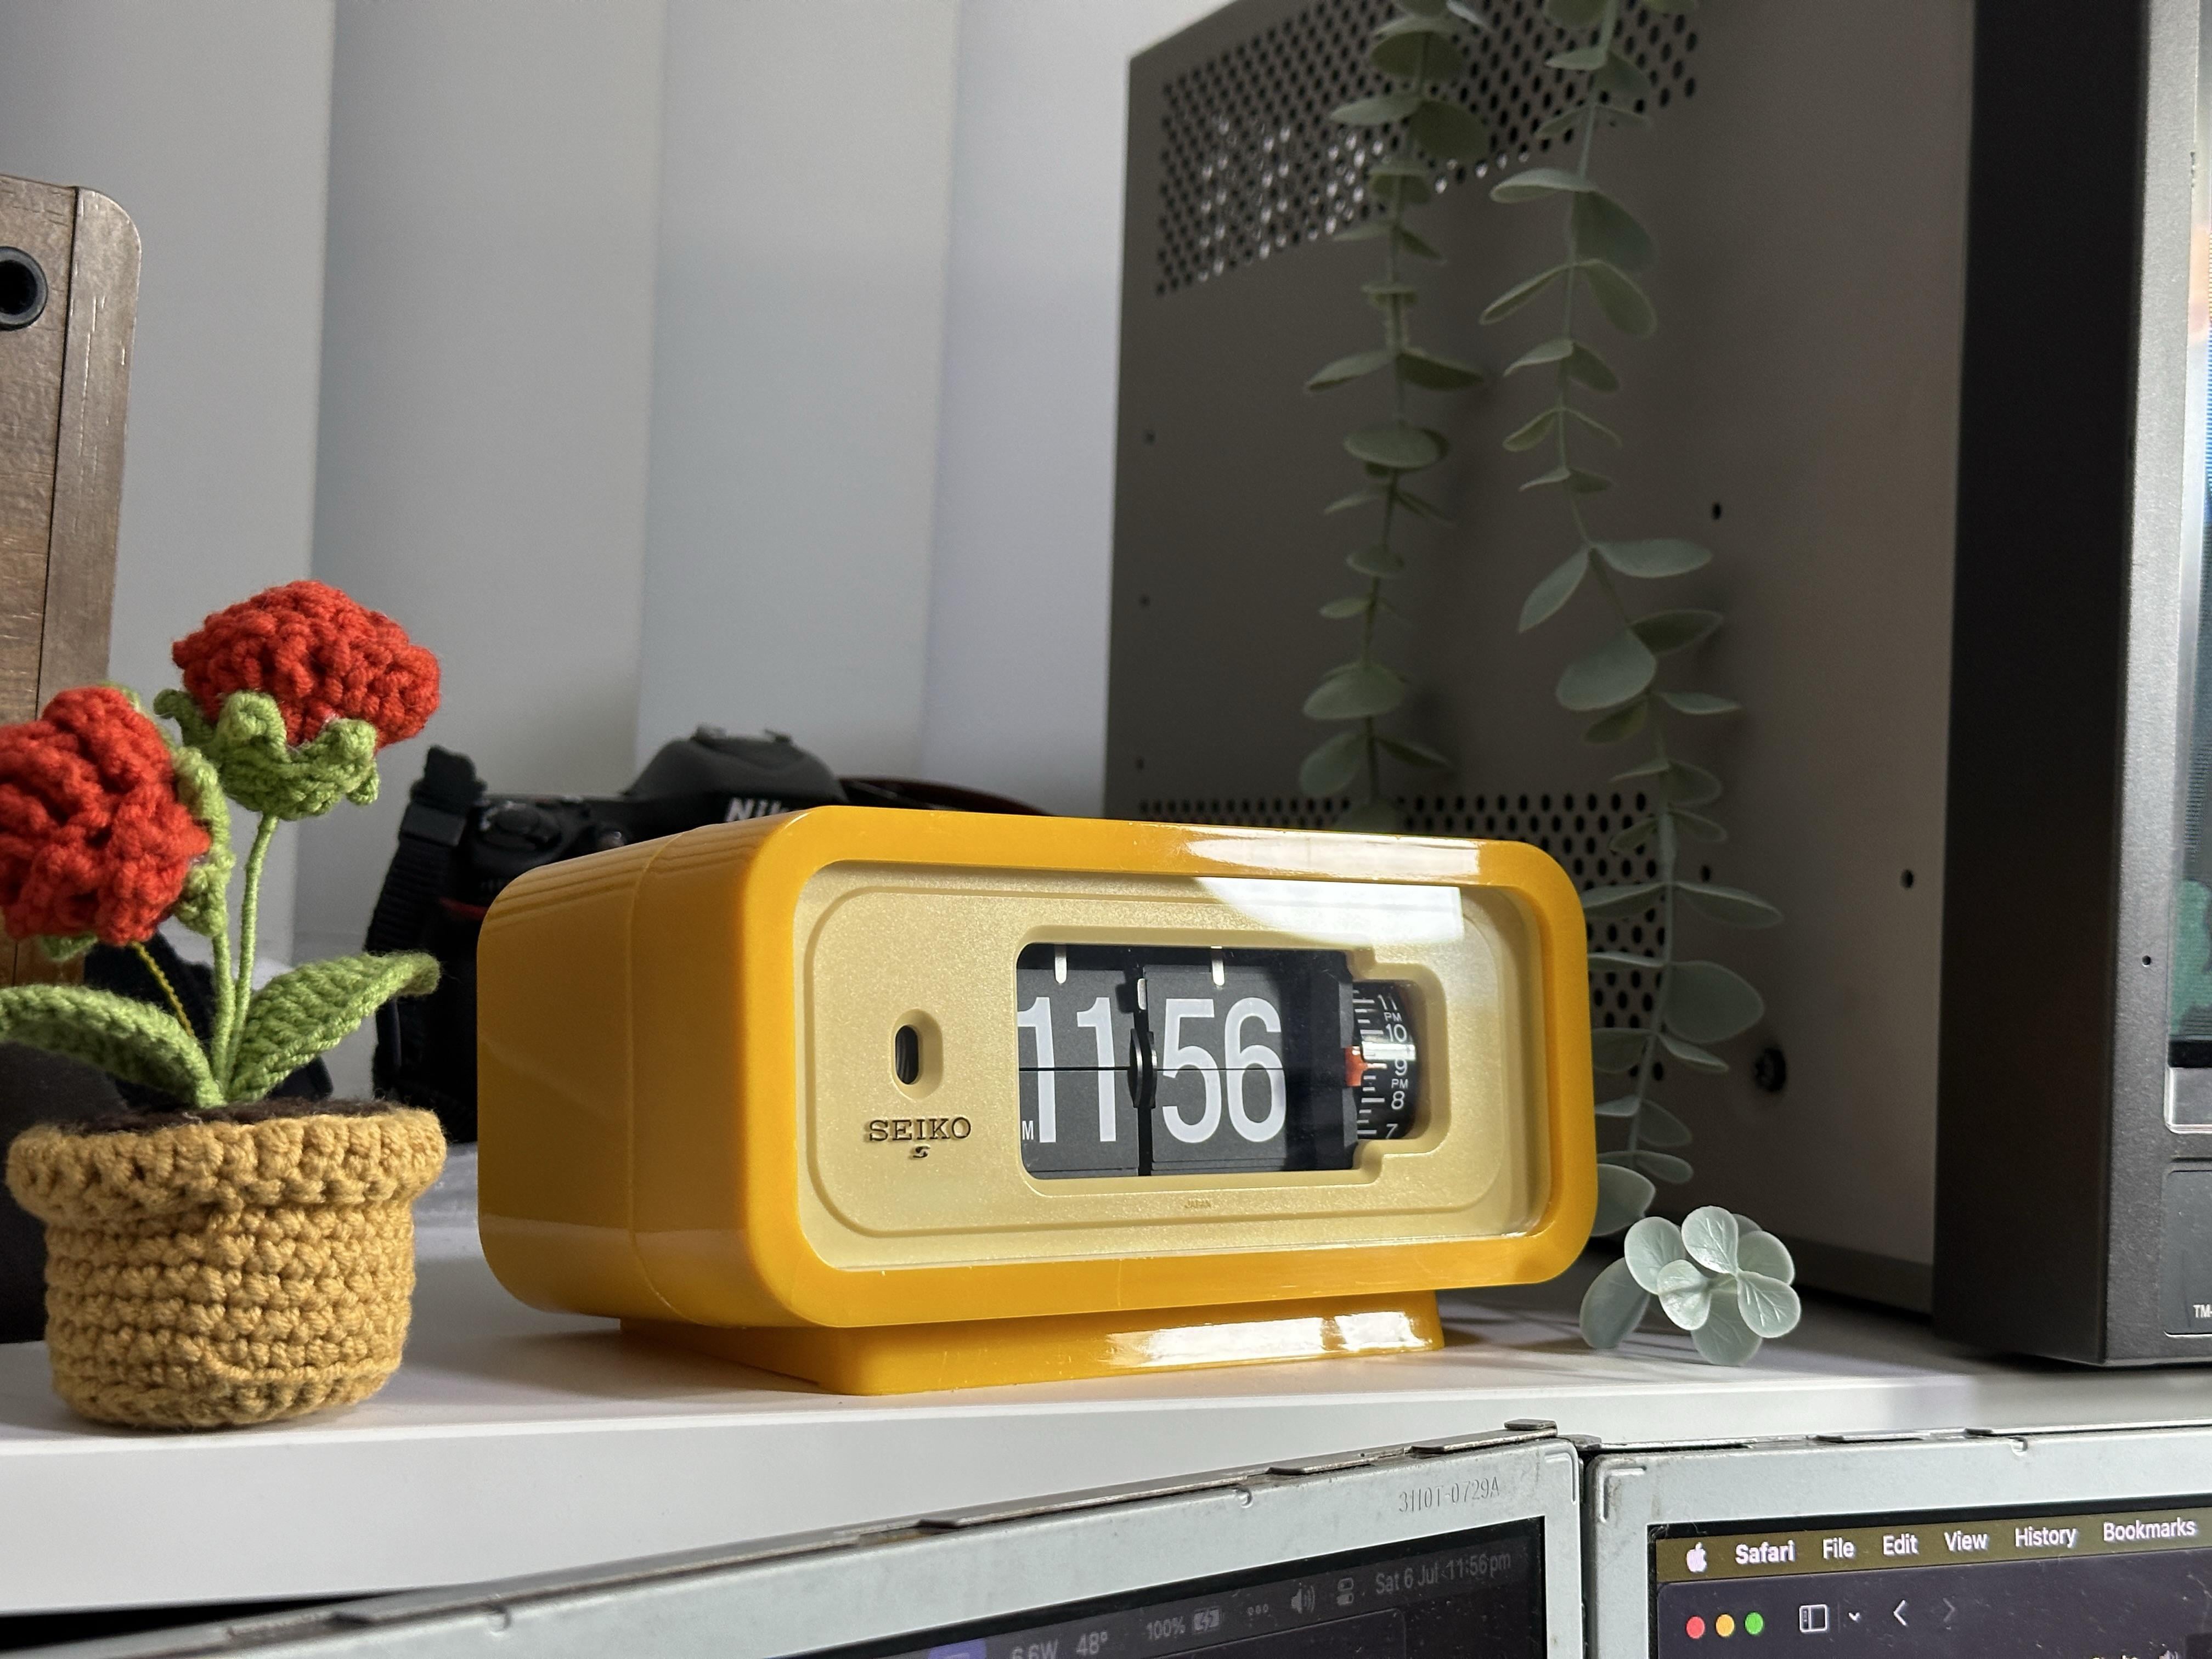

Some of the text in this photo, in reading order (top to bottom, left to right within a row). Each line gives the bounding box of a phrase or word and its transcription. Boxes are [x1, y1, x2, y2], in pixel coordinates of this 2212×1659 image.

[1384, 1012, 1402, 1022] PM
[1386, 1023, 1407, 1042] 10
[1017, 996, 1286, 1143] 11 56
[1395, 1058, 1408, 1076] 9
[1391, 1079, 1409, 1090] PM
[1391, 1091, 1406, 1110] 8
[870, 1116, 972, 1142] SEIKO
[1386, 1123, 1398, 1139] 7
[2193, 1304, 2212, 1318] TM-
[1735, 1516, 2198, 1565] Safari File Edit View History Bookmarks
[1147, 1615, 1186, 1640] 100%
[1375, 1570, 1400, 1594] Sat
[1404, 1567, 1414, 1589] 6
[1417, 1562, 1439, 1587] Jul
